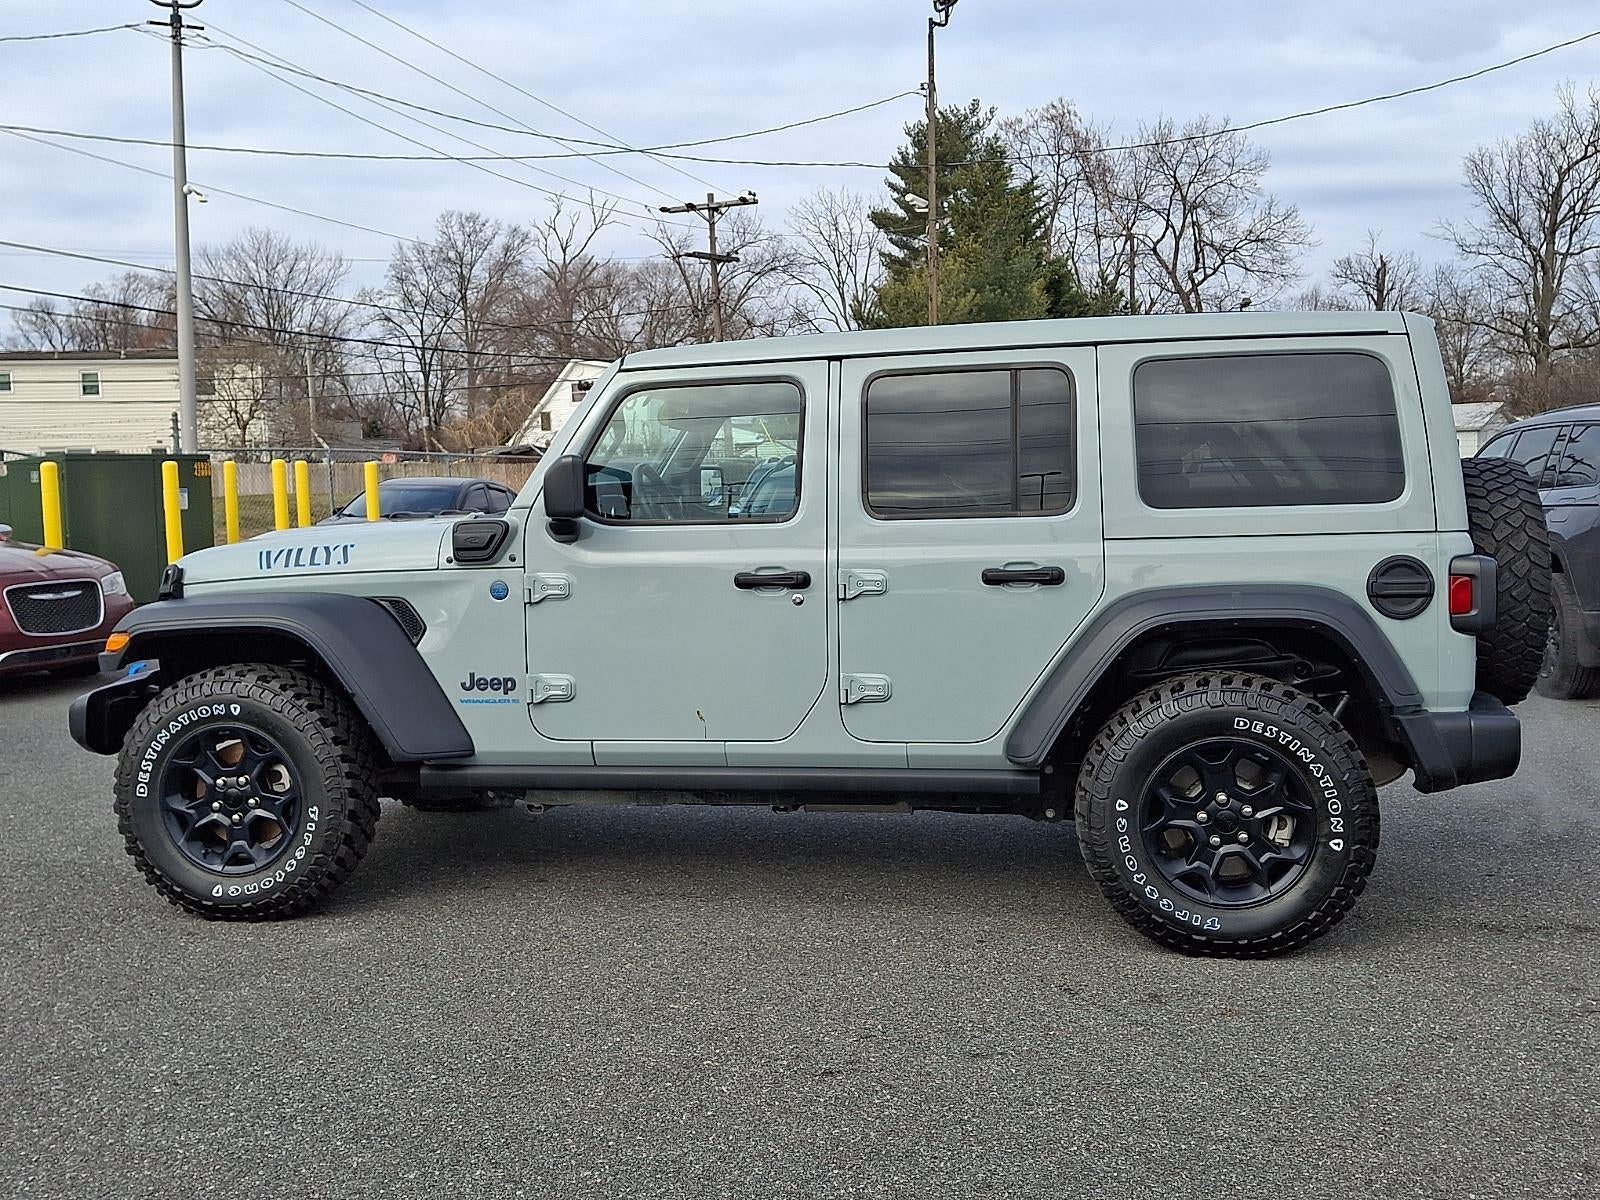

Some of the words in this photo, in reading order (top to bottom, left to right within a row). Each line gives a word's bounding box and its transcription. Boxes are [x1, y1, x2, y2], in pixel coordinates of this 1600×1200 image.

[258, 543, 355, 570] WILLYS
[460, 672, 517, 695] Jeep
[136, 704, 226, 798] DESTINATION
[1234, 717, 1344, 832] DESTINATION
